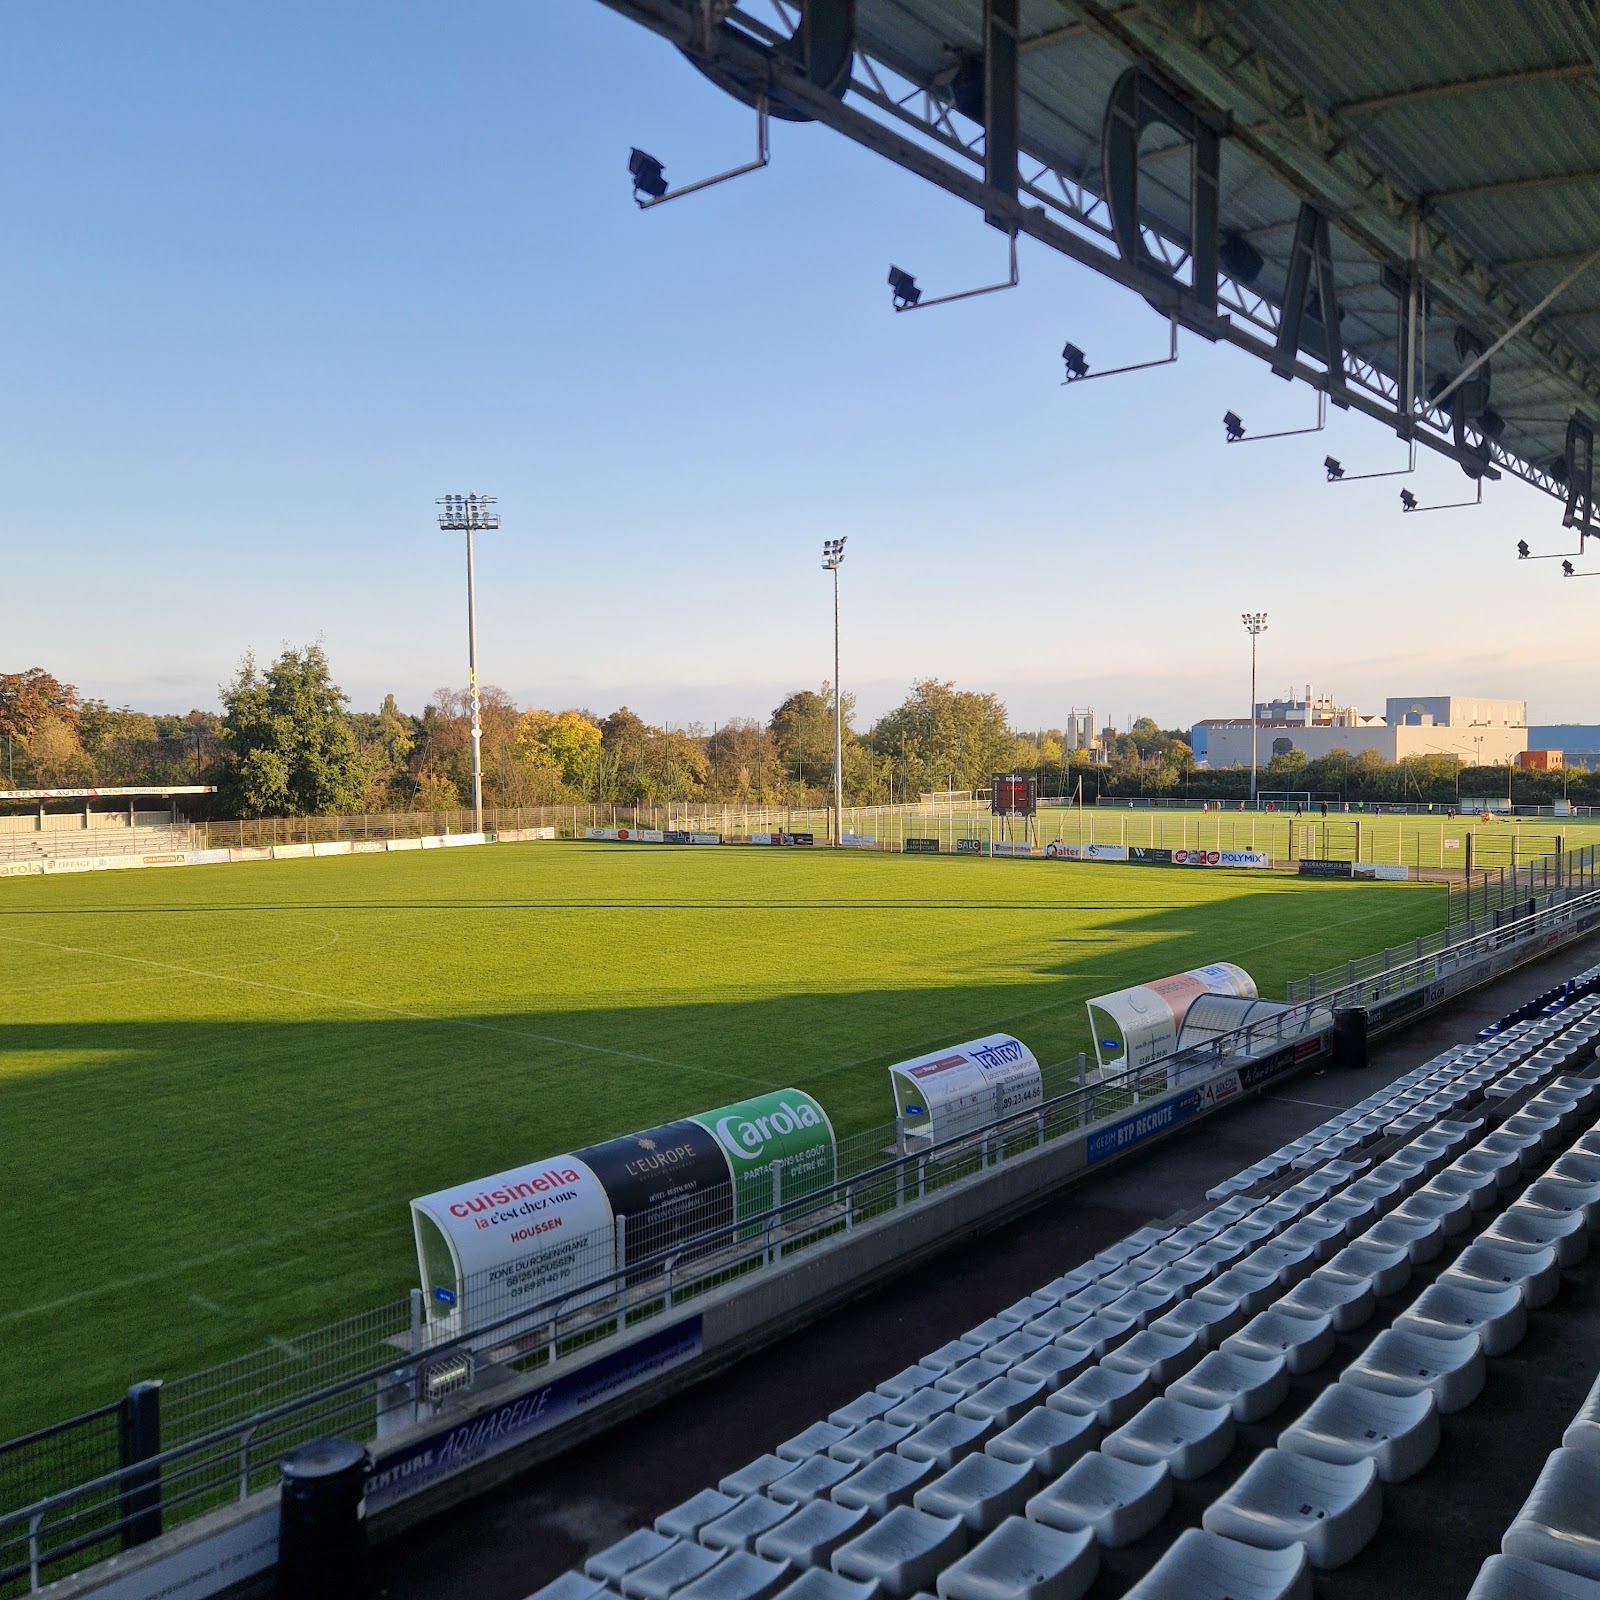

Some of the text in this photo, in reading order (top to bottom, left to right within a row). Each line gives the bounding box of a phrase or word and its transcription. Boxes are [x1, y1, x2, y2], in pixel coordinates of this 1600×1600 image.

[7, 790, 54, 798] REFLEX
[144, 856, 176, 864] CHAMPION
[1058, 846, 1080, 856] alter
[1221, 853, 1261, 863] POLYMIX
[0, 862, 43, 875] arola
[58, 860, 91, 869] EIFFAGE
[1011, 1060, 1035, 1072] TRANSPORT
[716, 1101, 821, 1160] Carola
[1096, 1105, 1173, 1149] GEZIM BTP RECRUTE
[625, 1144, 696, 1176] L'EUROPE
[744, 1144, 825, 1181] PARTAGONS LE GOÛT
[449, 1168, 581, 1218] cuisinella
[474, 1189, 578, 1230] là c'est chez vous
[511, 1217, 563, 1243] HOUSSEN
[489, 1238, 588, 1281] ZONE DU ROSENKRANZ
[532, 1254, 576, 1276] HOUSSEN
[511, 1286, 523, 1298] 03
[437, 1387, 552, 1466] AQUARELLE
